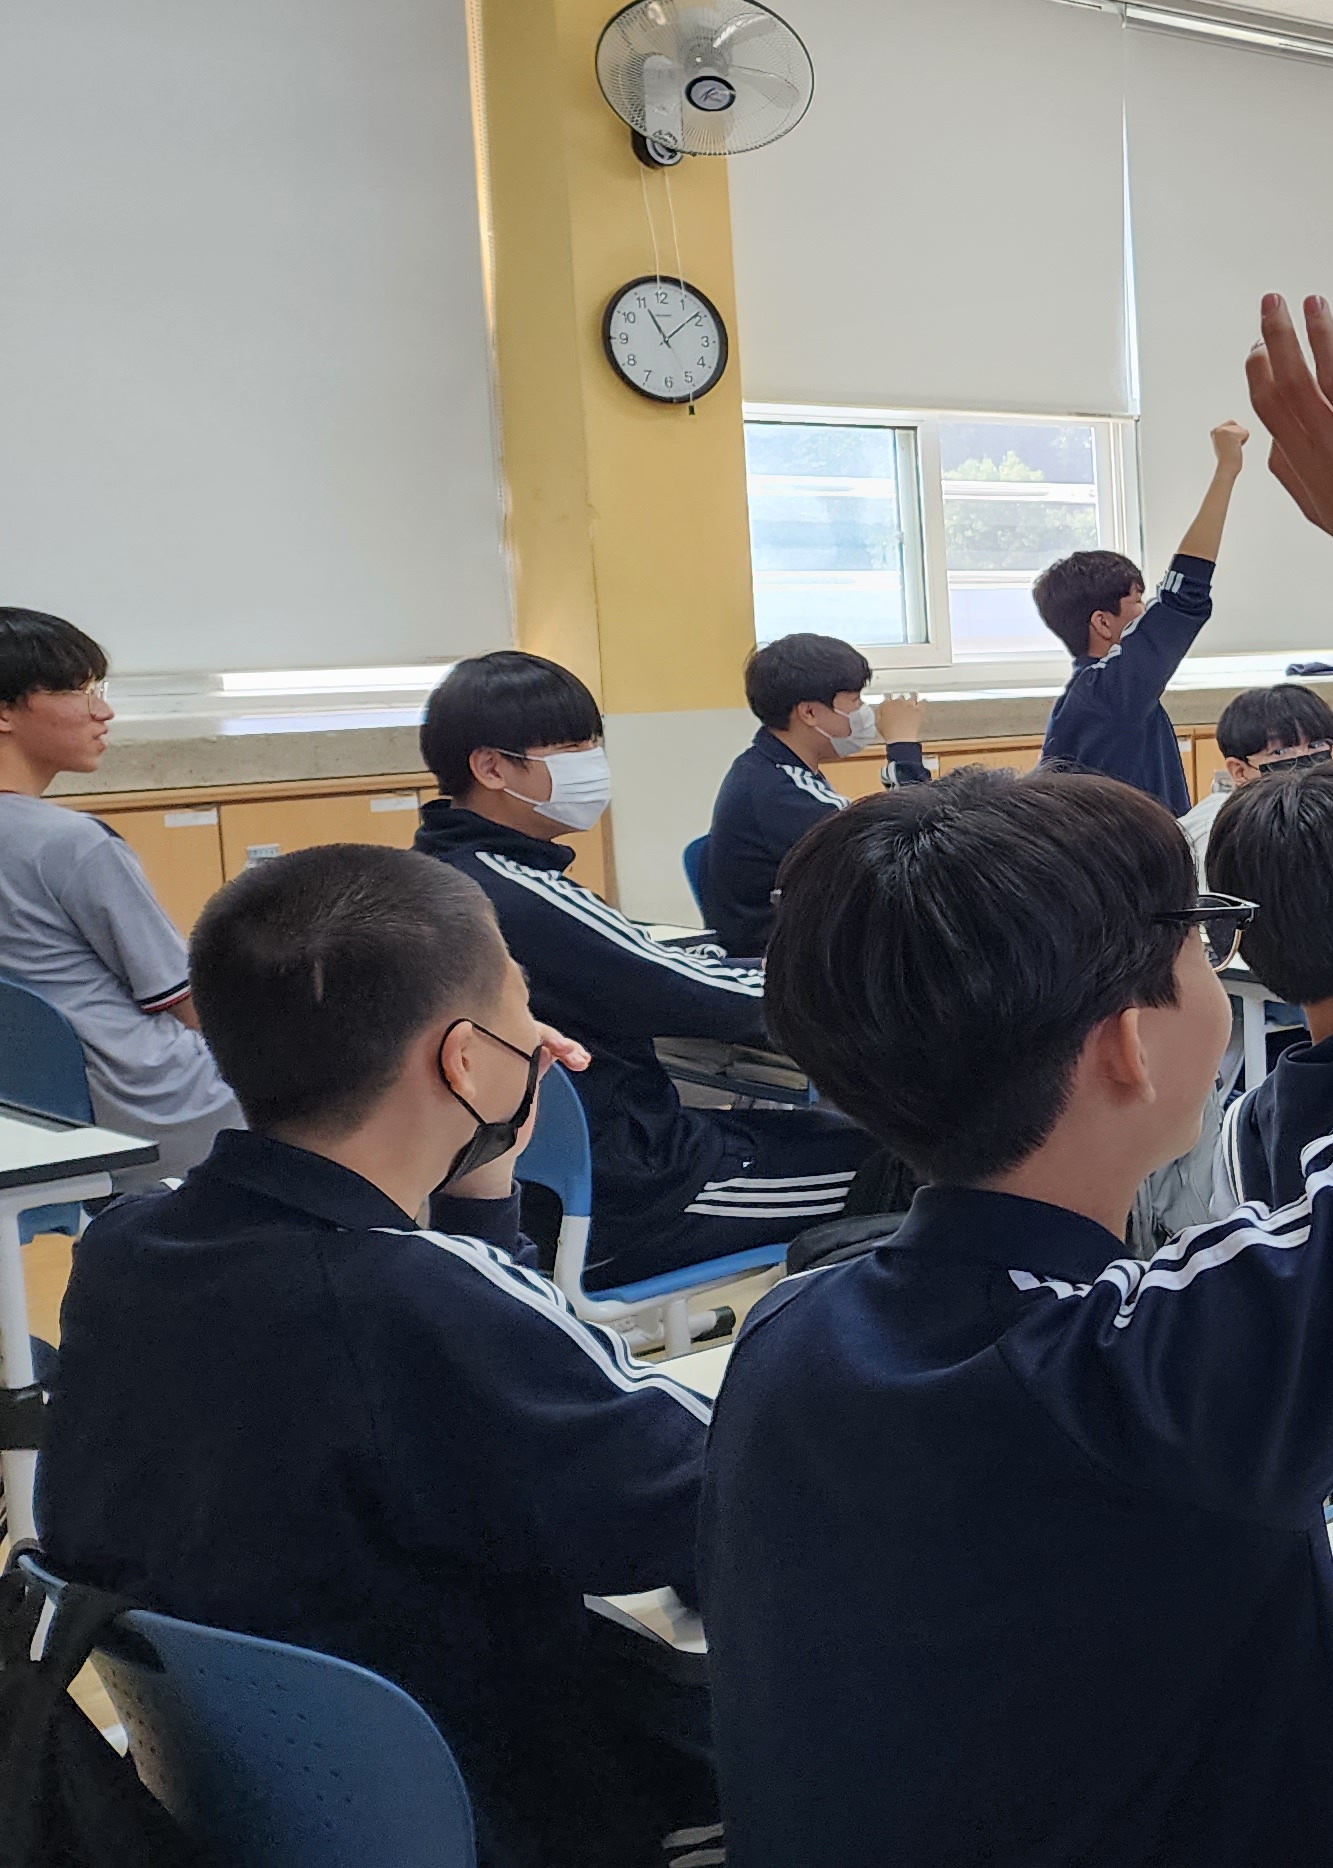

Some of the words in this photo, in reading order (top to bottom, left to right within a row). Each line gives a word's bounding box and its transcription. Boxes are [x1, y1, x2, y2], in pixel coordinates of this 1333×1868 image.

[636, 296, 647, 309] 11
[655, 291, 669, 305] 12
[680, 299, 685, 311] 1
[623, 311, 636, 323] 10
[695, 312, 704, 327] 2
[619, 332, 629, 345] 9
[701, 335, 710, 348] 3
[627, 354, 637, 366] 8
[696, 356, 706, 368] 4
[643, 370, 652, 382] 7
[664, 376, 674, 388] 6
[684, 370, 693, 383] 5
